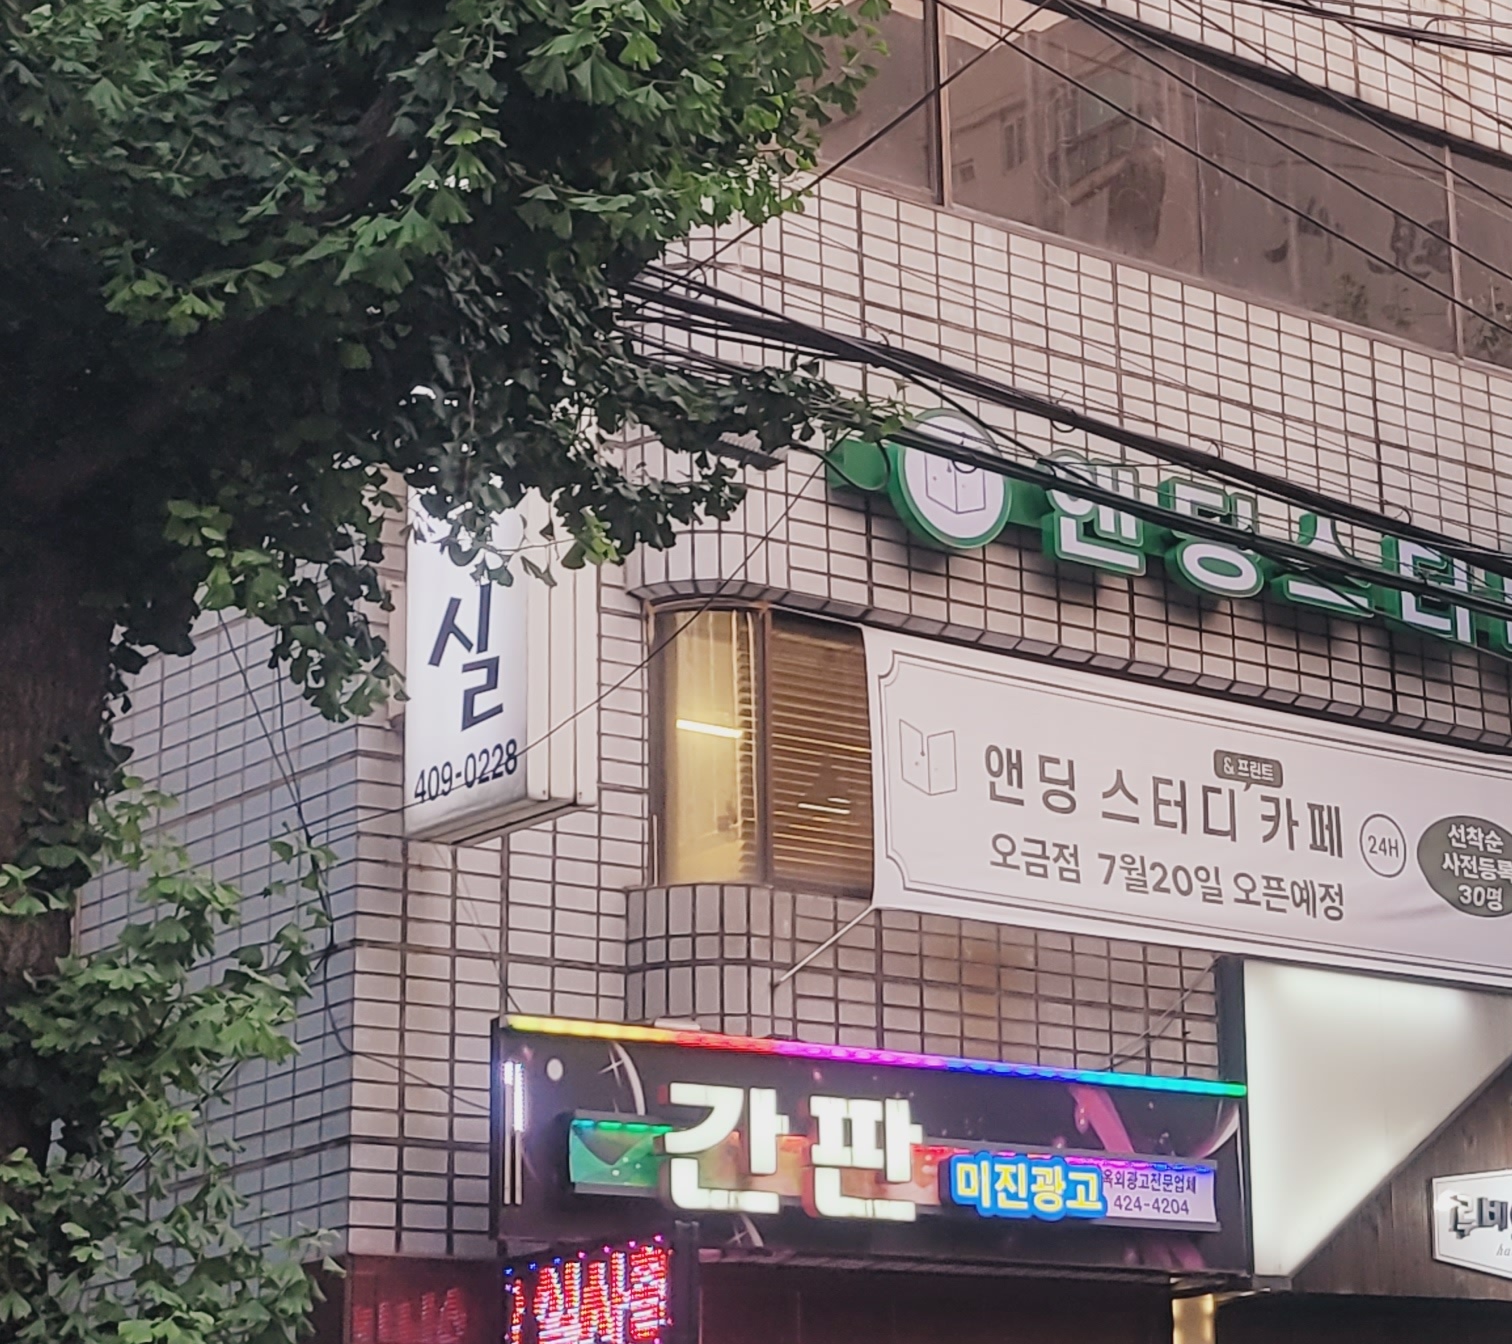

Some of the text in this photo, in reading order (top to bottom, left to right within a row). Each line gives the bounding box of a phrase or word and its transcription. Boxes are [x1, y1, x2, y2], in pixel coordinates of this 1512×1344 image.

[413, 738, 518, 803] 409-0228
[984, 743, 1078, 816] 앤딩
[1237, 758, 1274, 781] 프린트
[1367, 831, 1400, 859] 24H
[1448, 823, 1504, 855] 선착순
[989, 832, 1346, 922] 오금점 7월20일 오픈예정
[1457, 883, 1505, 913] 30명
[664, 1082, 922, 1223] 간판
[955, 1159, 1104, 1213] 미진광고
[1113, 1195, 1190, 1215] 424-4204
